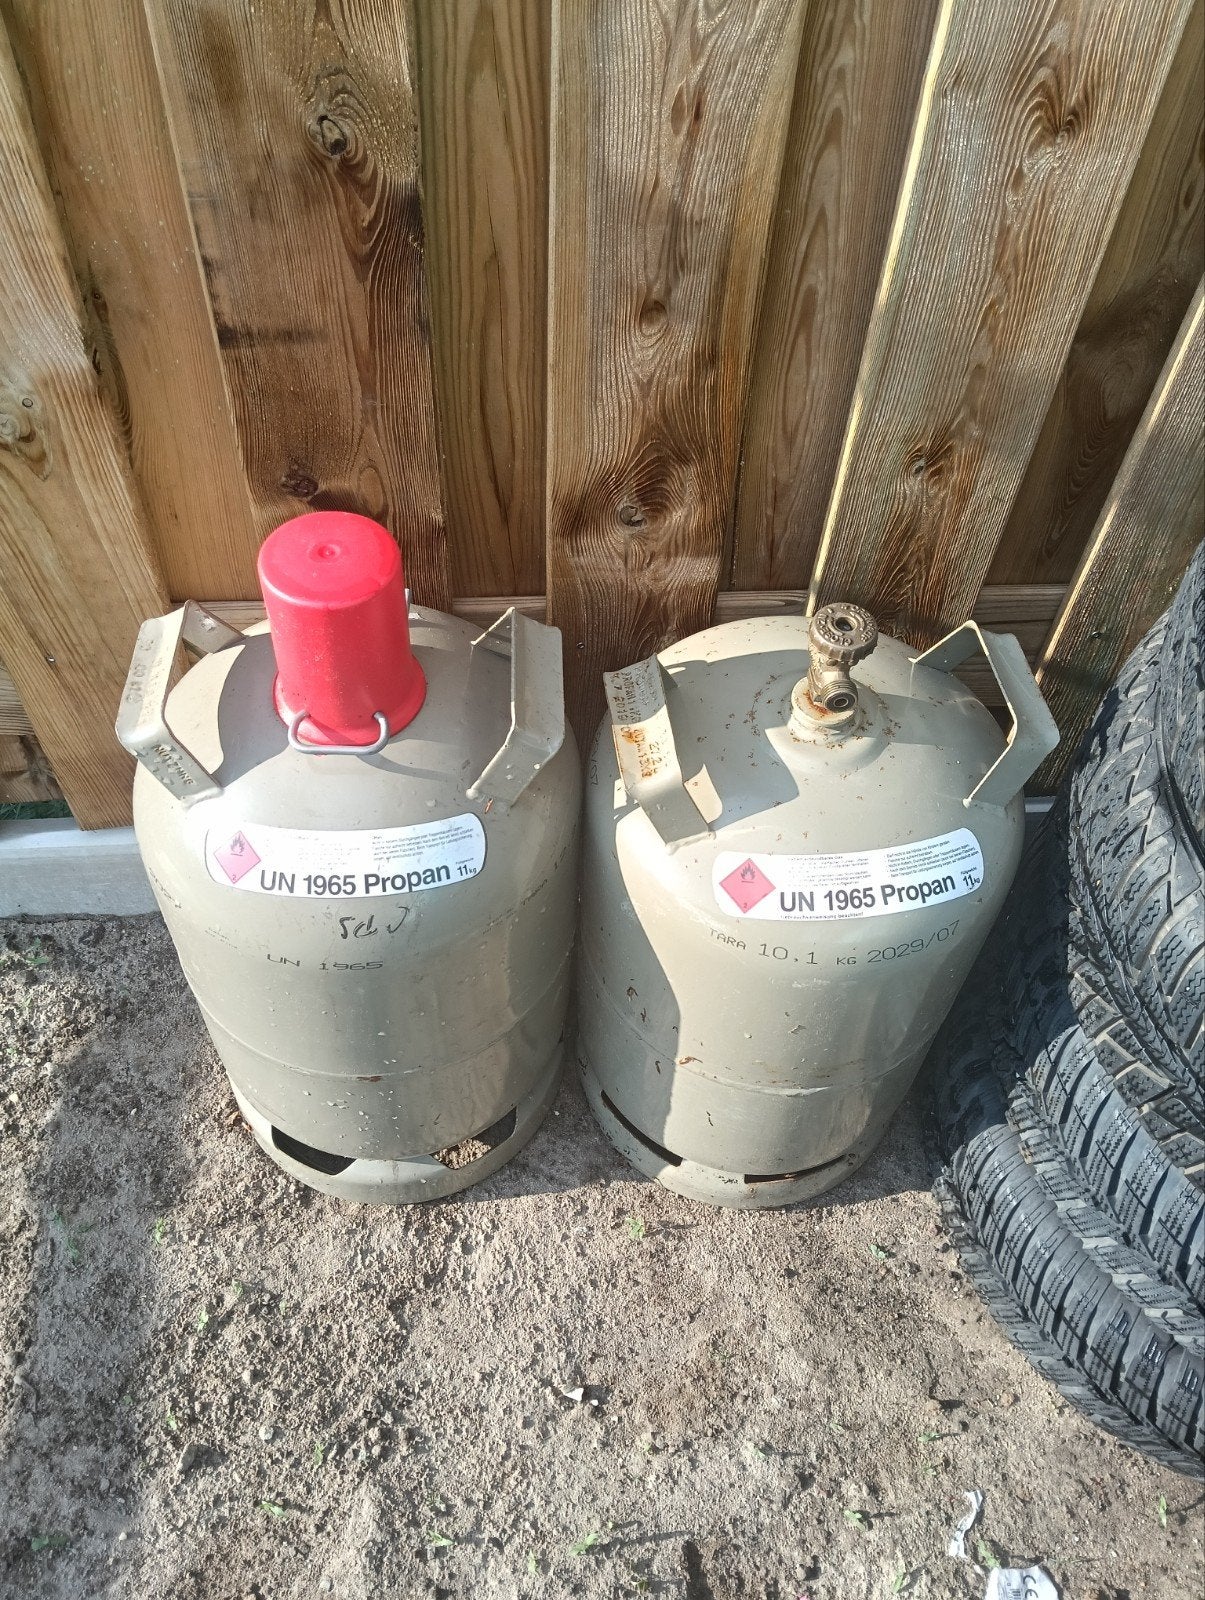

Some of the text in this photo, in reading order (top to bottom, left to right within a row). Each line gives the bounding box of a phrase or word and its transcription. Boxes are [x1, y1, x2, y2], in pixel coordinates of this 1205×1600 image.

[260, 869, 296, 894] UN
[303, 874, 356, 896] 1965
[364, 864, 451, 894] Propan
[780, 891, 815, 912] UN
[823, 887, 876, 911] 1965
[880, 875, 957, 904] Propan
[709, 927, 747, 950] TARA
[836, 956, 857, 965] KG
[867, 919, 960, 963] 2029/07
[267, 953, 383, 971] UN 1965
